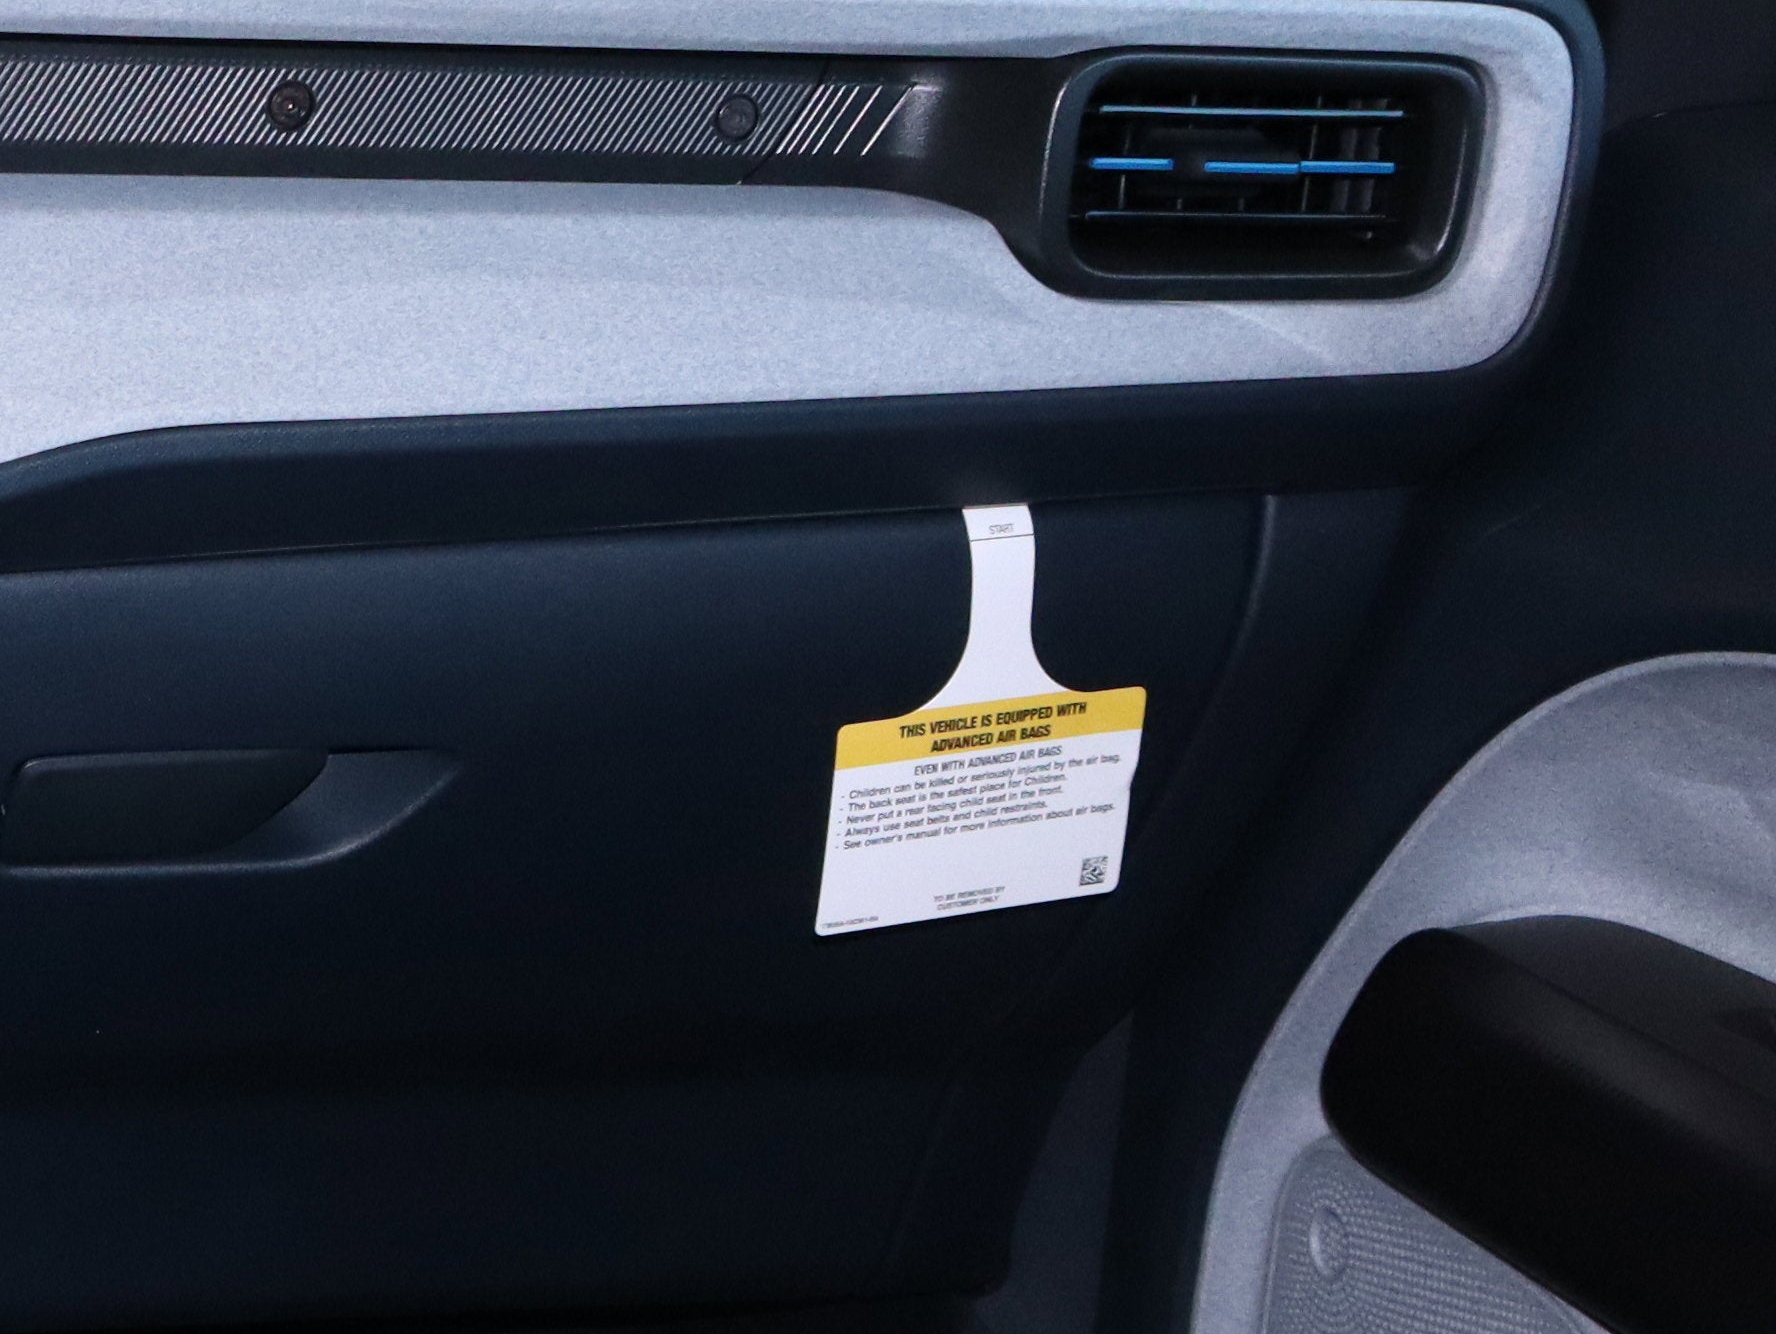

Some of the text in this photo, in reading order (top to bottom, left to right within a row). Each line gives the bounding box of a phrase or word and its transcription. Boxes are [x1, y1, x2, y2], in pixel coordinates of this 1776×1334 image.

[989, 523, 1015, 535] START
[900, 702, 1087, 738] THIS VEHICLE IS EQUIPPED WITH
[931, 725, 1051, 752] ADVANCED AIR BAGS
[849, 754, 1120, 799] Children can be killed or seriously injured by the air bag.
[914, 746, 1062, 775] EVEN WITH ADVANCED AIR BAGS
[847, 813, 874, 824] Never
[878, 810, 894, 821] put
[905, 807, 924, 815] rear
[928, 802, 957, 815] facing
[959, 797, 983, 808] child
[987, 794, 1006, 804] seat
[1009, 792, 1017, 800] in
[1021, 790, 1036, 798] the
[1039, 786, 1063, 796] front.
[849, 773, 1067, 811] The back seat is the safest place for Children.
[843, 803, 1115, 850] See owner's manual for more information about air bags.
[845, 800, 1047, 837] Always use seat belts and child restraints.
